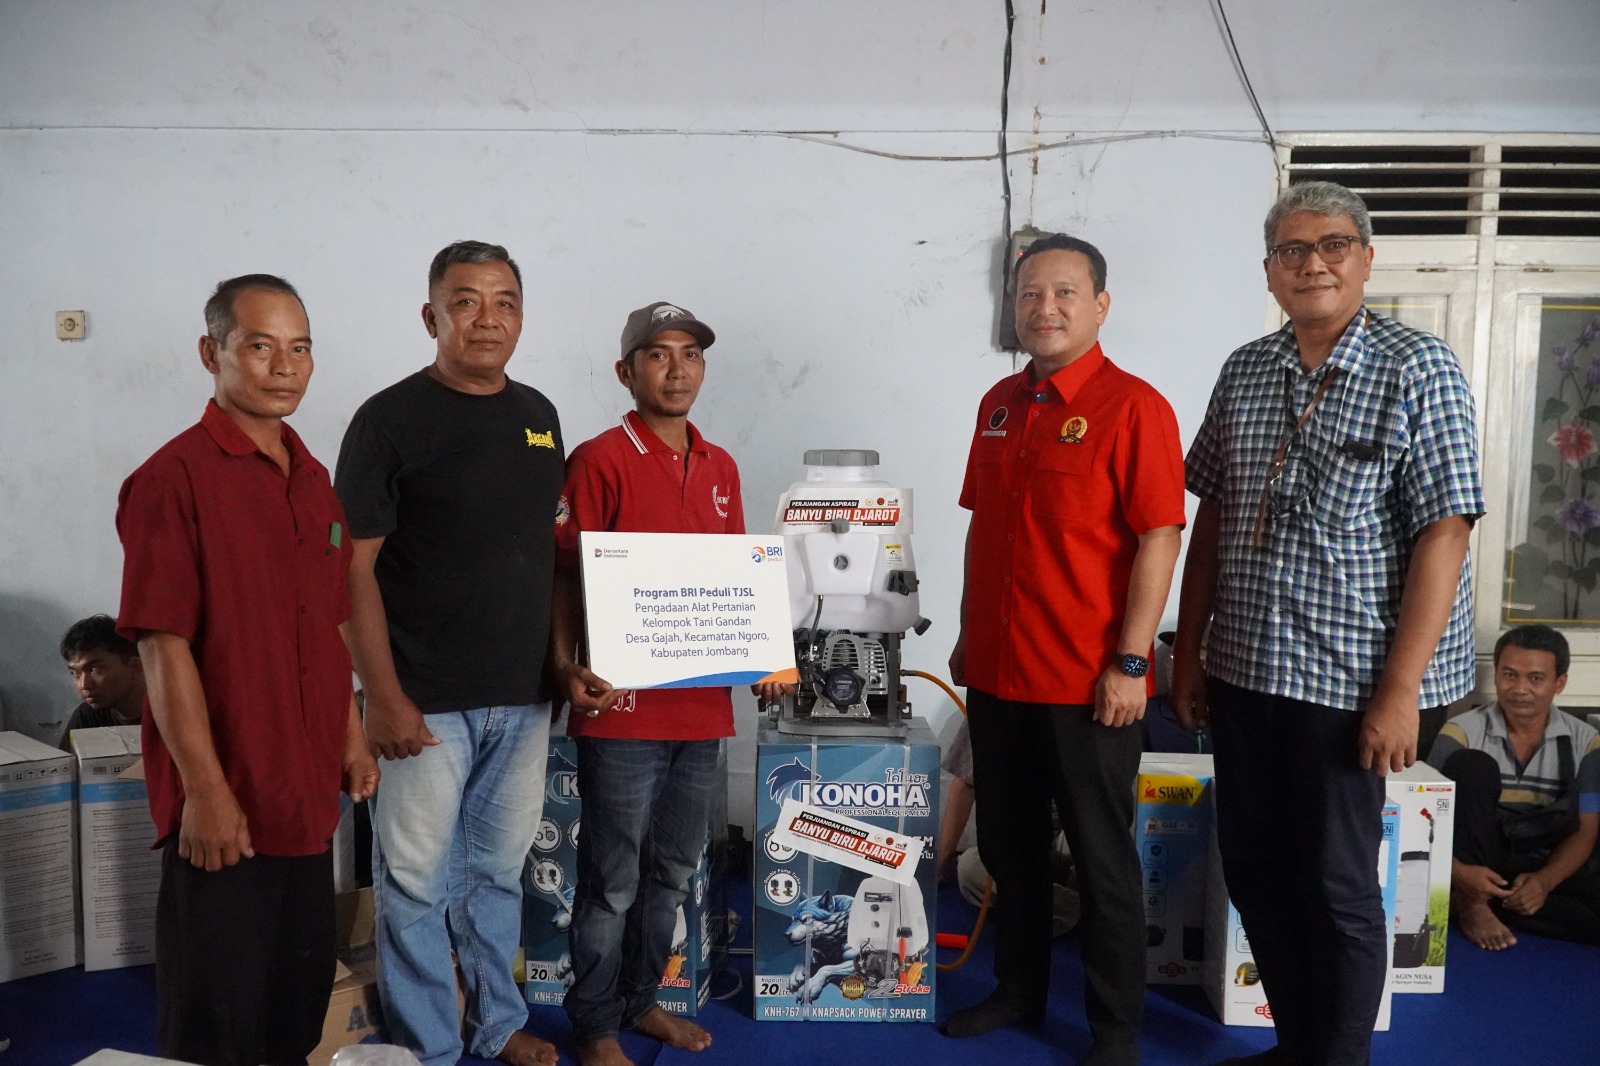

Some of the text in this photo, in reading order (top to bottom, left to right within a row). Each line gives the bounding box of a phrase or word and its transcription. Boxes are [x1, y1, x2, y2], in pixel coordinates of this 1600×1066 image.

[786, 509, 896, 521] BANYU BIRU DJAROT
[767, 546, 783, 556] BRI
[633, 587, 755, 600] Program BRI Peduli TJSL
[635, 602, 756, 614] Pengadaan Alat Pertanian
[642, 616, 751, 630] Kelompok Tani Gandan
[625, 631, 770, 645] Desa Gajah, Kecamatan Ngoro,
[651, 647, 749, 659] Kabupaten Jombang
[802, 783, 928, 807] KONOHA
[1158, 786, 1194, 800] SWAN
[834, 808, 930, 817] PROFESSIONAL EQUIPMENT
[802, 813, 841, 830] PERJUANGAN
[792, 819, 830, 839] BANYU
[830, 830, 857, 849] BIRU
[857, 841, 902, 864] DJAROT
[530, 968, 548, 981] 20
[659, 976, 691, 988] troke
[846, 981, 861, 990] HIGH
[868, 978, 931, 999] 2 Stroke
[760, 983, 779, 996] 20
[764, 1006, 800, 1017] KNH-767
[812, 1007, 856, 1018] KNAPSACK
[858, 1007, 887, 1018] POWER
[889, 1008, 927, 1019] SPRAYER
